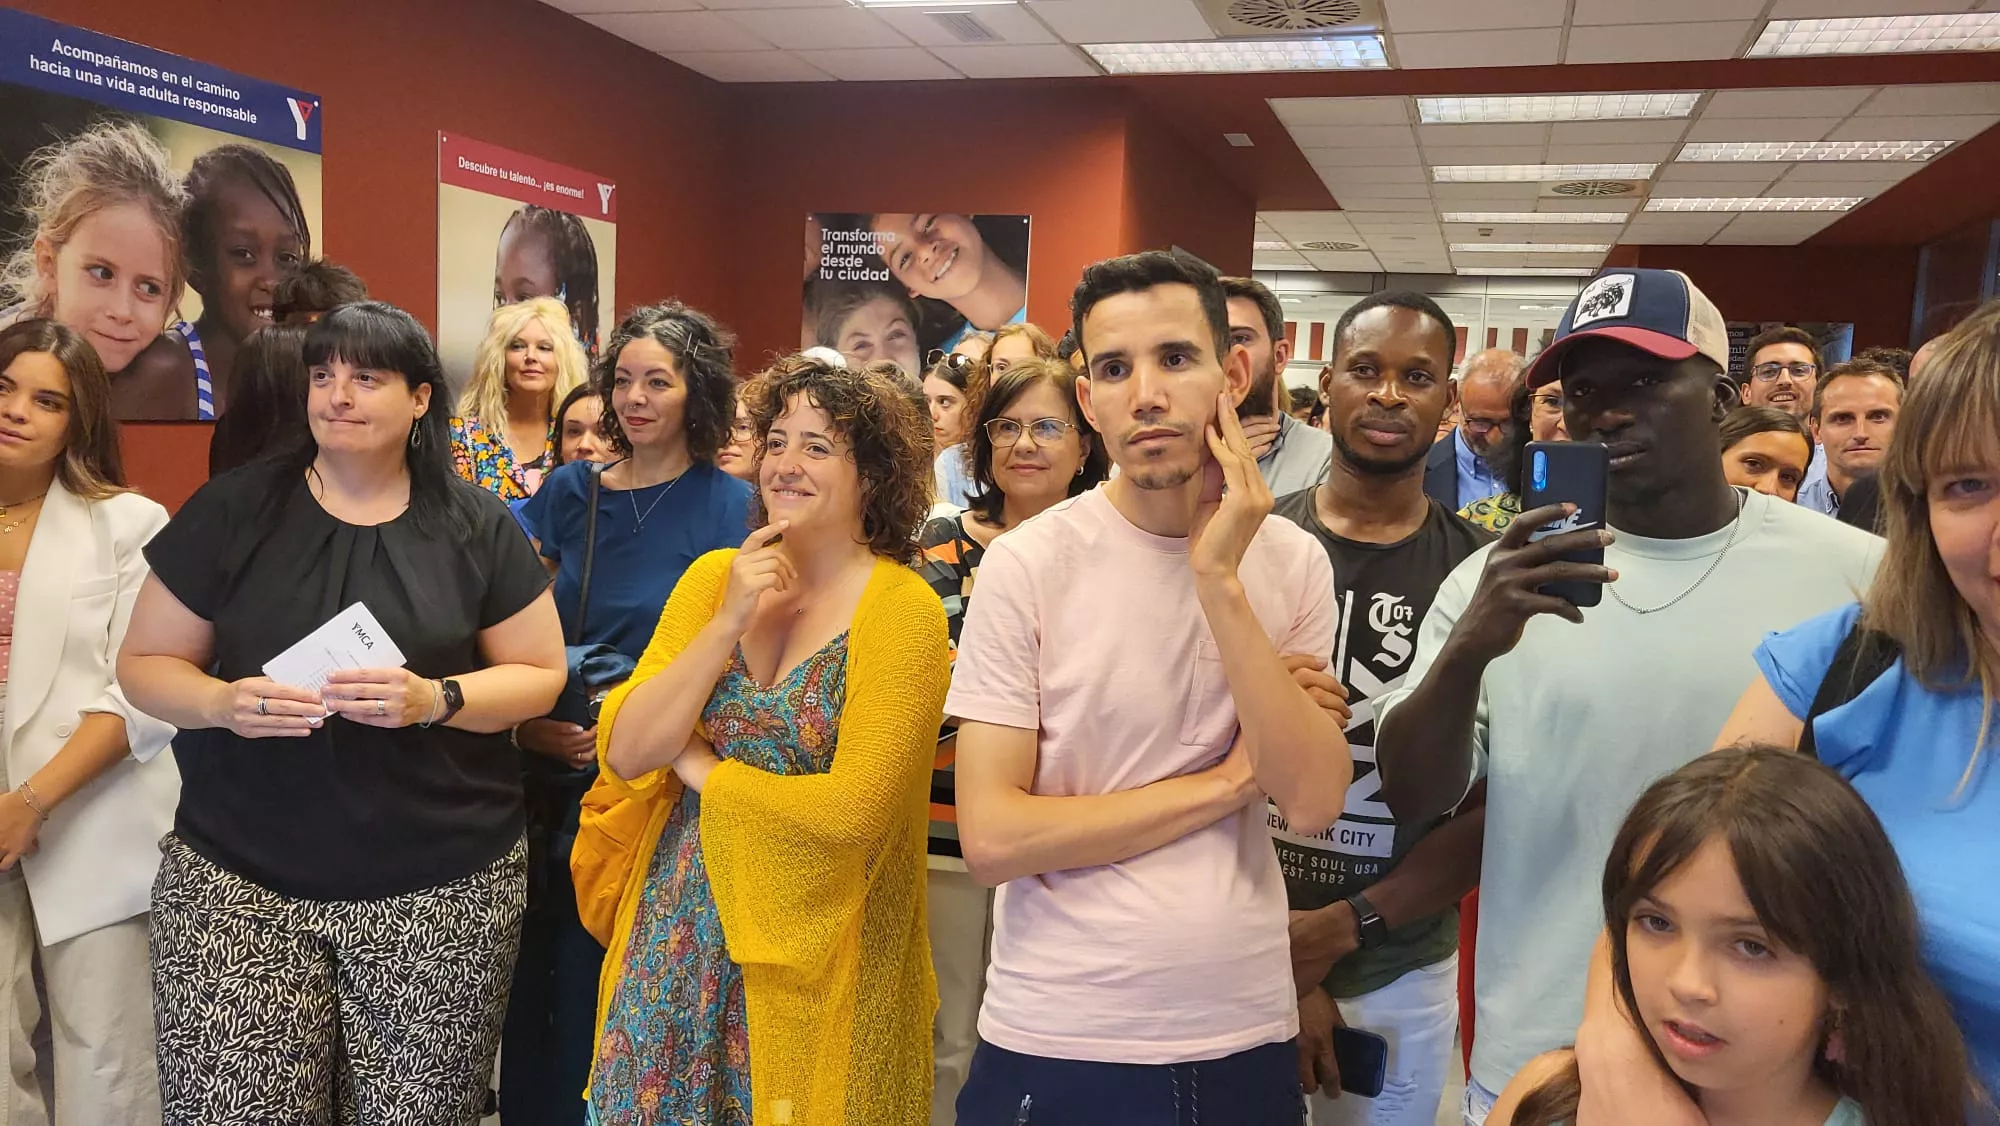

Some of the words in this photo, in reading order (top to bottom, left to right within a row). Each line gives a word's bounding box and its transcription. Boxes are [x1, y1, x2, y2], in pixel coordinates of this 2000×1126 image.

[51, 39, 158, 79] Acompañamos
[162, 71, 178, 85] en
[181, 74, 192, 89] el
[196, 80, 241, 101] camino
[30, 54, 71, 79] hacia
[75, 69, 102, 86] una
[106, 75, 136, 94] vida
[139, 81, 180, 105] adulta
[183, 96, 258, 125] responsable
[458, 156, 498, 177] Descubre
[500, 169, 508, 180] tu
[509, 169, 542, 189] talento...
[543, 181, 555, 192] ¡es
[556, 183, 585, 199] enorme!
[821, 228, 896, 242] Transforma
[821, 242, 833, 254] el
[837, 242, 886, 255] mundo
[820, 255, 863, 267] desde
[820, 267, 833, 280] tu
[838, 268, 890, 281] ciudad
[351, 621, 374, 650] YMCA
[1340, 829, 1376, 848] CITY
[1310, 856, 1347, 872] SOUL
[1355, 863, 1379, 875] USA
